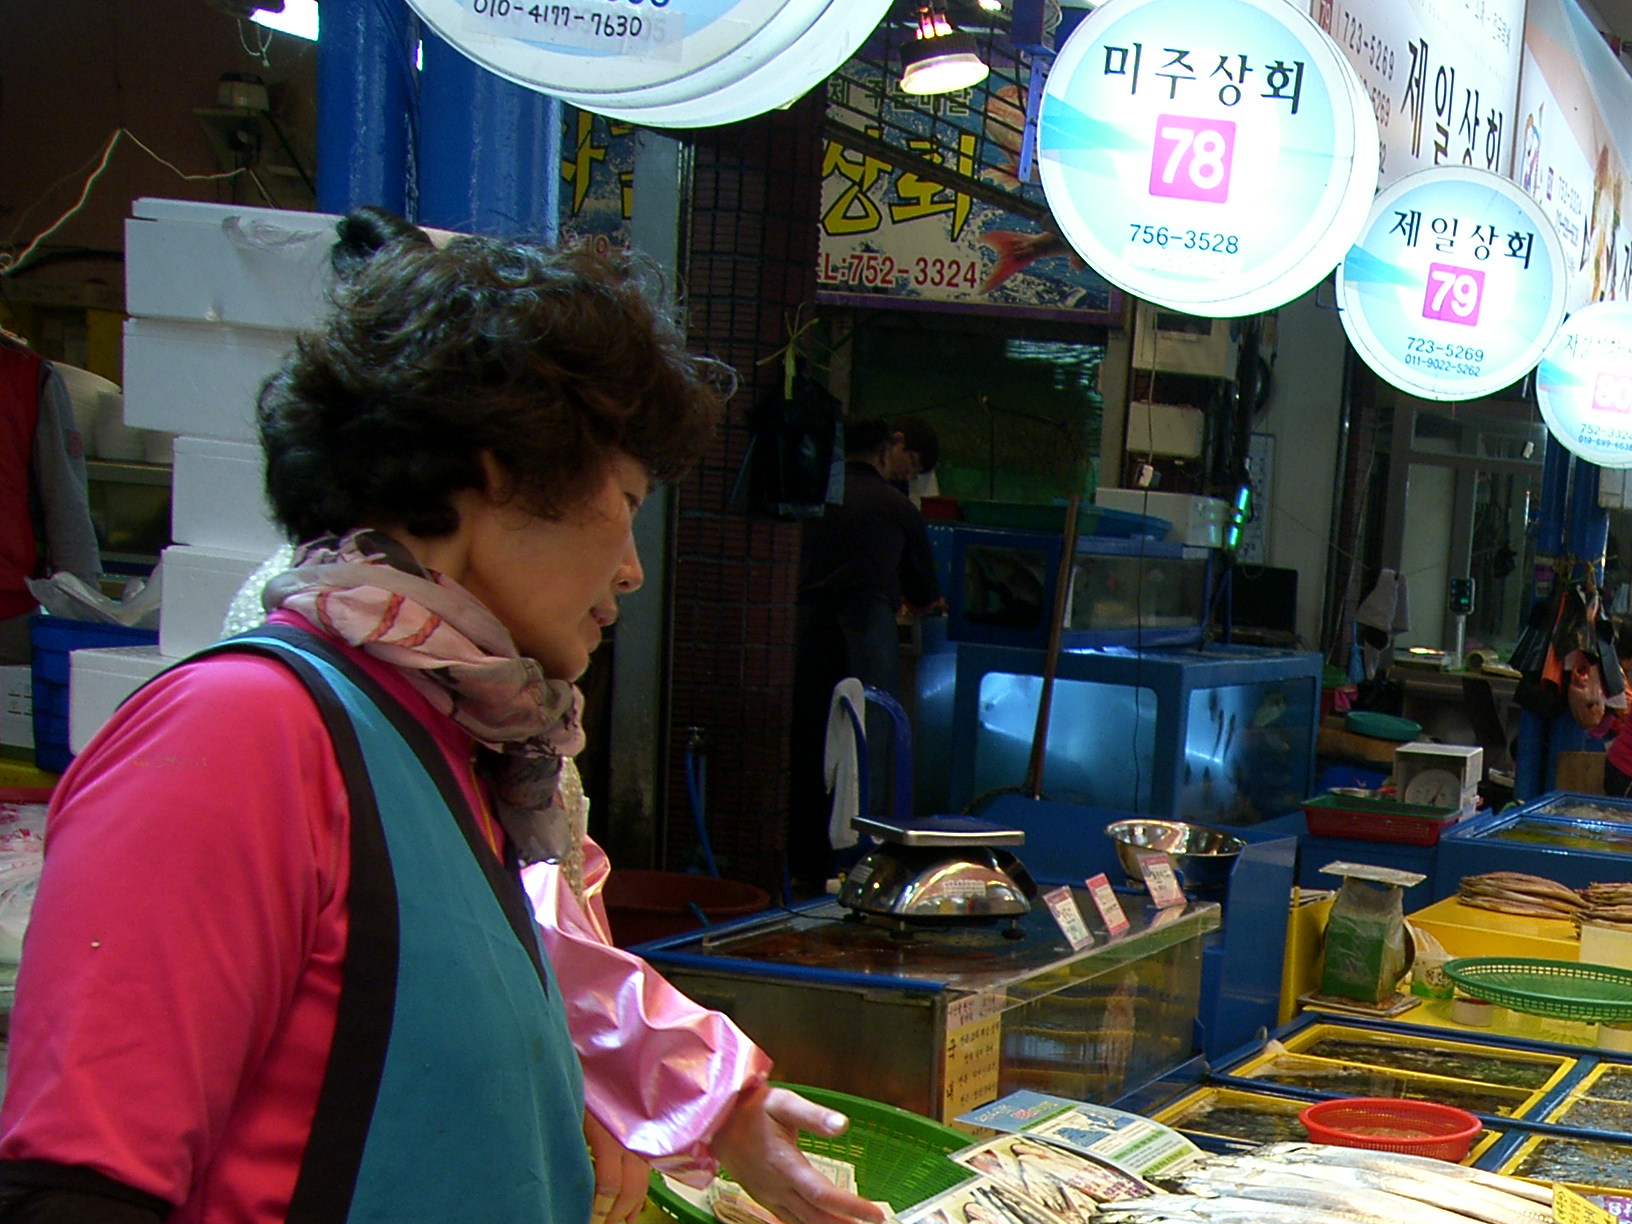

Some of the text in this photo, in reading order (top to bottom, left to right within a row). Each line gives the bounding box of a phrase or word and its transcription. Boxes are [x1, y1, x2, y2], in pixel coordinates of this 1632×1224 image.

[1343, 11, 1395, 81] 723-5269
[1103, 42, 1305, 115] 미주상회
[1401, 37, 1503, 172] 제일상회
[1159, 126, 1228, 190] 78
[1129, 223, 1240, 255] 756-3528
[1388, 208, 1535, 270] 제일상회
[1429, 269, 1480, 319] 79
[1404, 353, 1482, 378] 011-9022-5262
[1406, 335, 1485, 363] 723-5269
